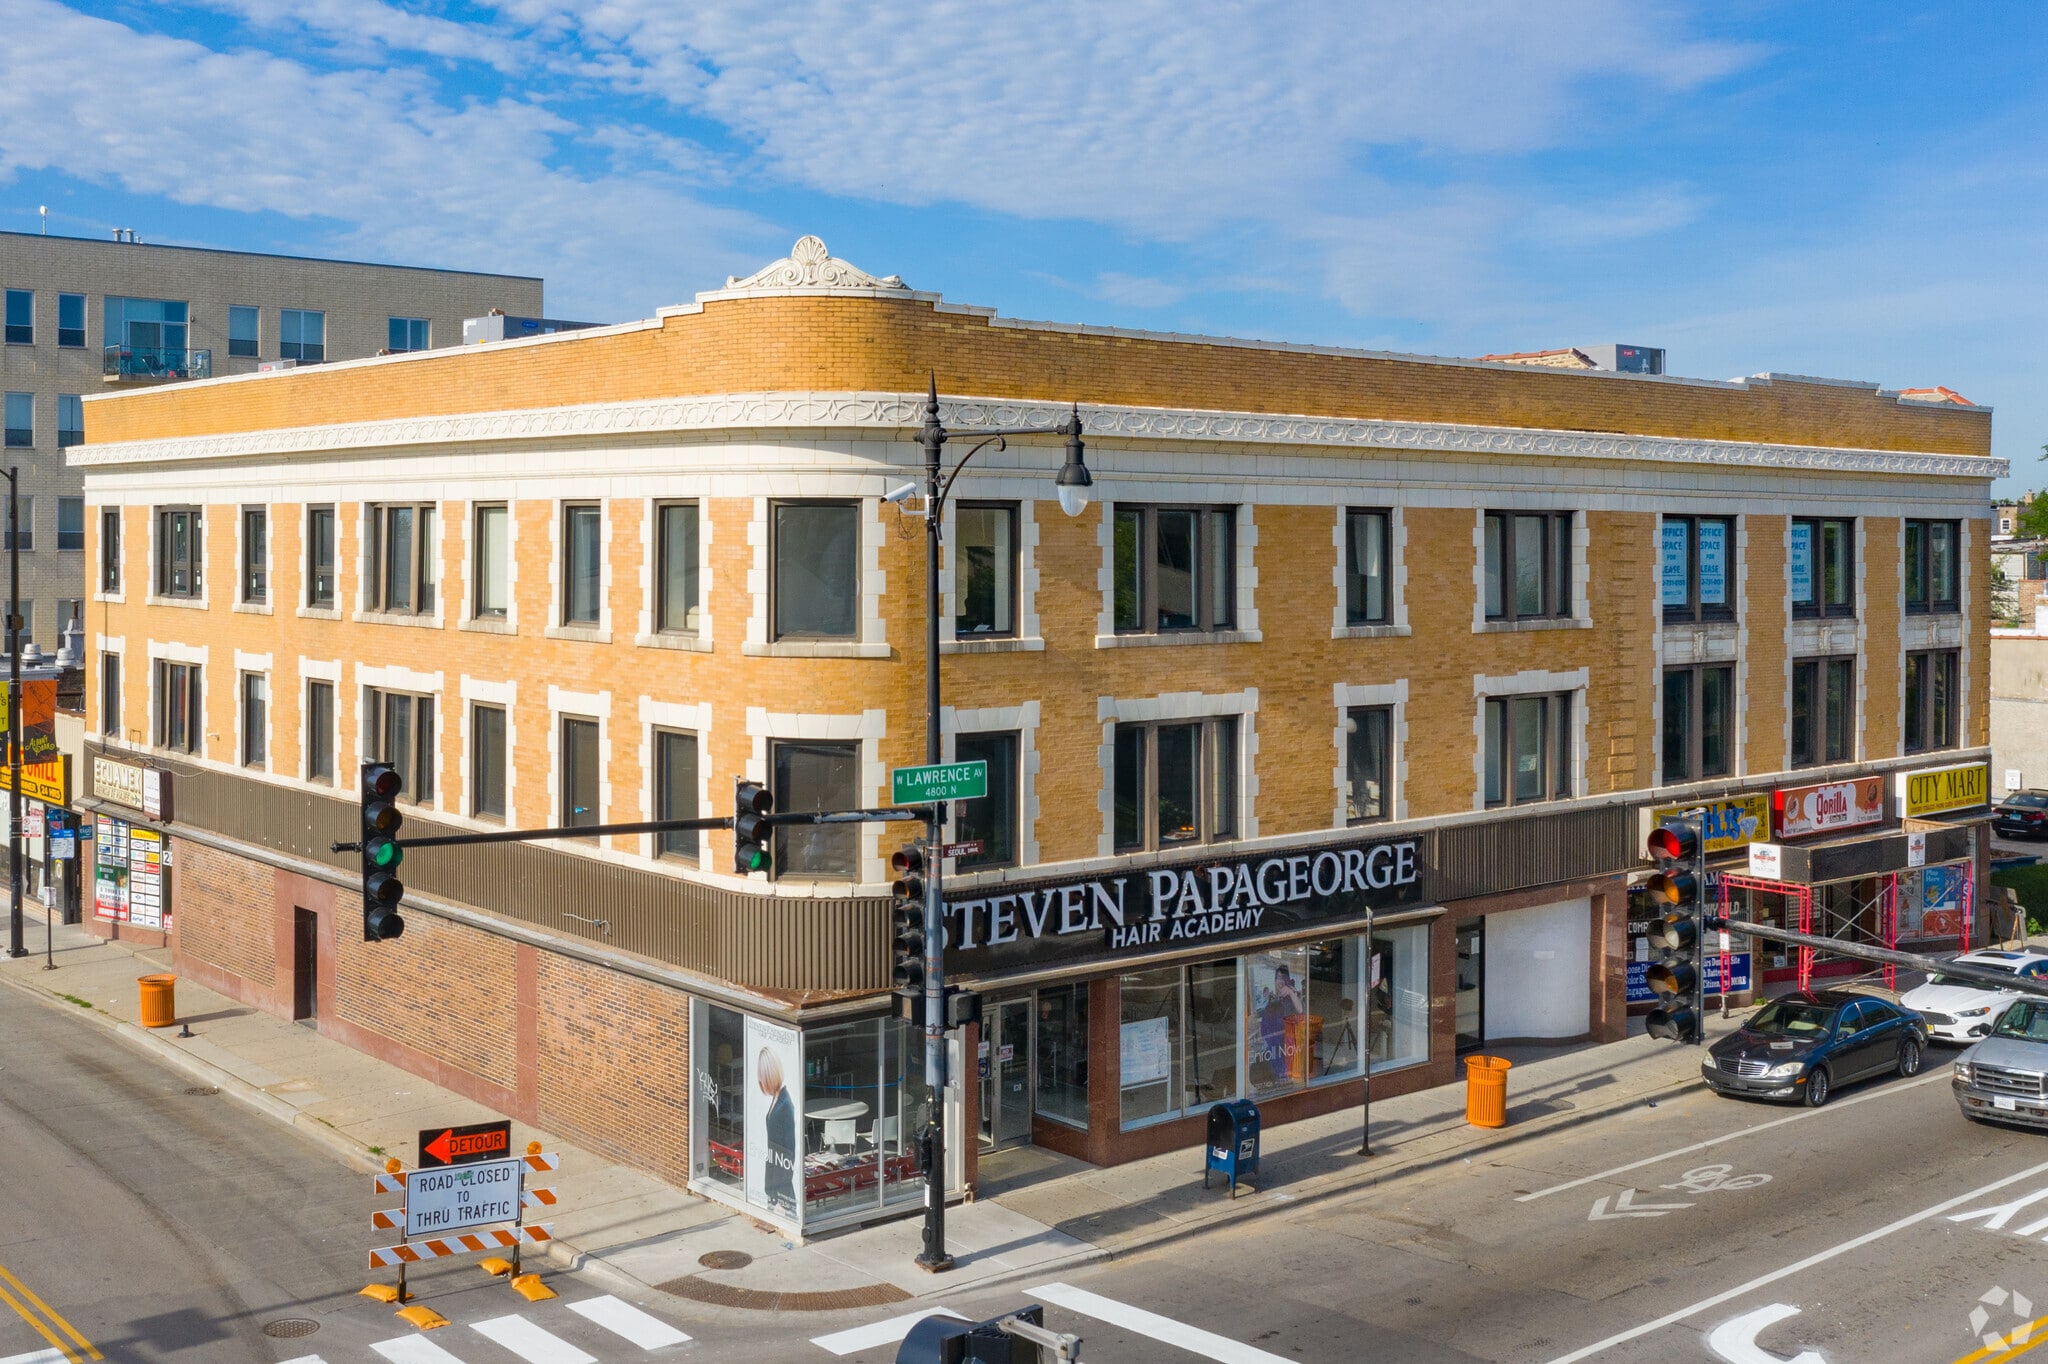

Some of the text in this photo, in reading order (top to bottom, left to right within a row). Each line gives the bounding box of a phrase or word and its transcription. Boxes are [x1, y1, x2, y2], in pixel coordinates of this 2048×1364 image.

[1699, 528, 1723, 537] OFFICE
[1700, 541, 1721, 550] SPACE
[1700, 565, 1719, 573] LEASE
[896, 767, 984, 787] W LAWRENCE AV
[1910, 768, 1984, 804] CITY MART
[925, 785, 957, 797] 4800 N
[947, 847, 966, 857] SEOUL
[1149, 841, 1416, 922] PAPAGEORGE
[1112, 907, 1265, 949] HAIR ACADEMY
[450, 1134, 502, 1153] DETOUR
[420, 1167, 510, 1193] ROAD CLOSED
[457, 1191, 470, 1203] TO
[416, 1200, 510, 1228] THRU TRAFFIC
